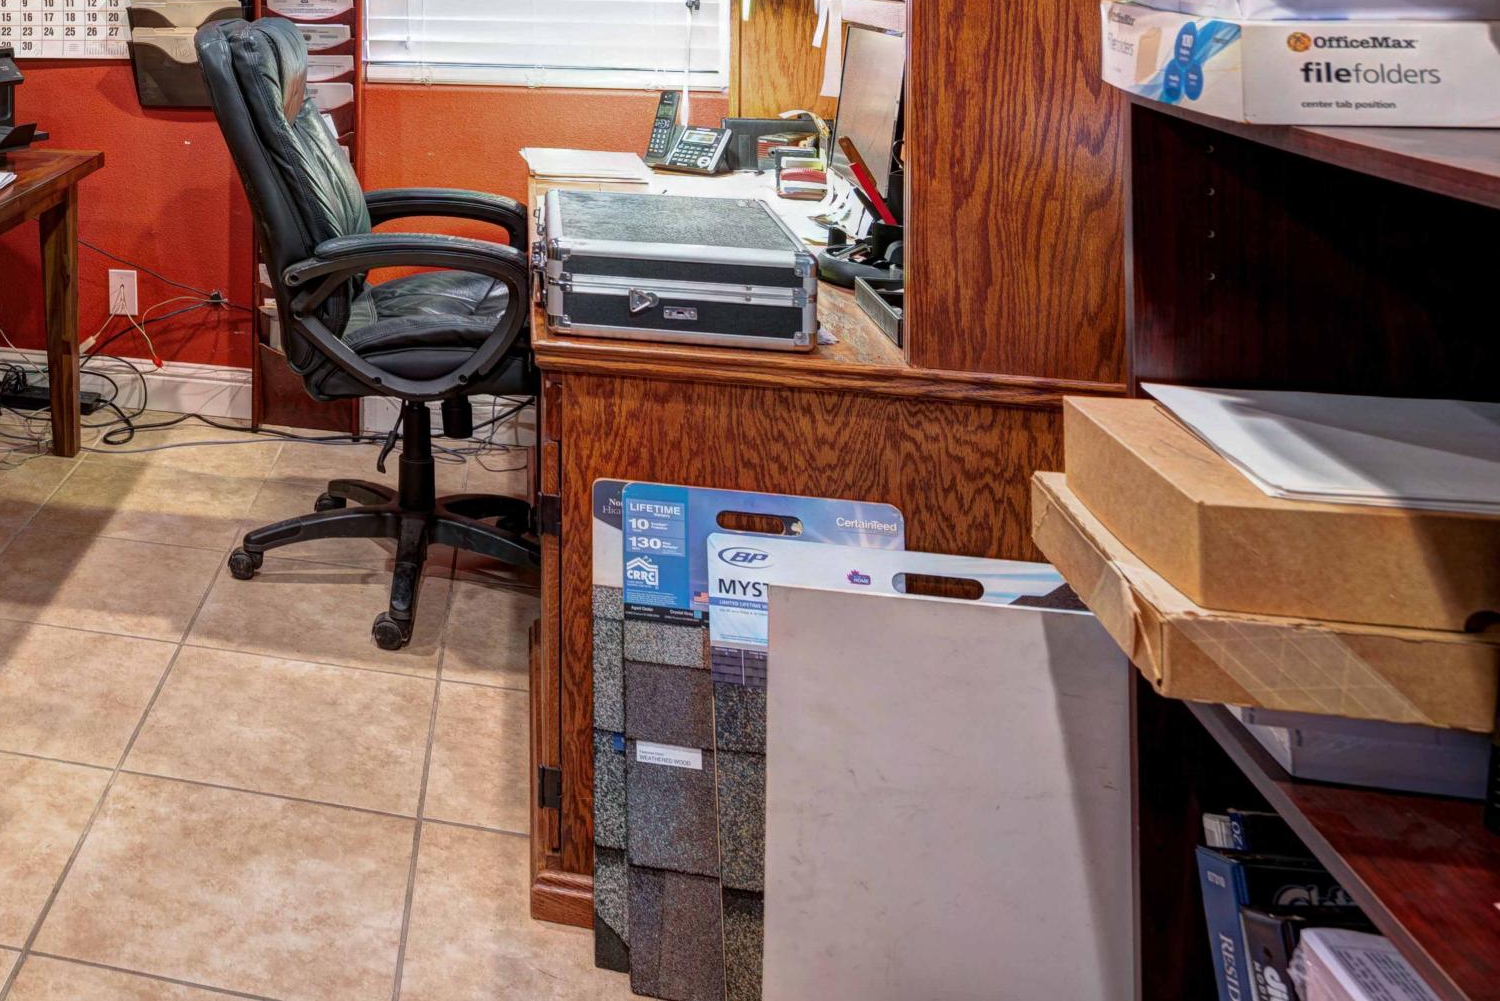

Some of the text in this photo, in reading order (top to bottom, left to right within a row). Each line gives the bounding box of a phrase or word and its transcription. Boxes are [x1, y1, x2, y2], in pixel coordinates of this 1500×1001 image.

[2, 13, 11, 22] 15
[23, 13, 32, 22] 16
[44, 13, 54, 22] 17
[65, 13, 75, 22] 18
[87, 13, 97, 22] 19
[109, 13, 118, 22] 20
[1, 27, 11, 36] 22
[23, 27, 32, 36] 23
[44, 27, 54, 36] 24
[65, 27, 75, 36] 25
[87, 27, 97, 36] 26
[109, 27, 119, 36] 27
[23, 42, 32, 50] 30
[1314, 36, 1417, 49] OfficeMax
[1301, 62, 1441, 84] filefolders
[1355, 101, 1396, 109] position
[609, 498, 623, 506] No
[630, 503, 681, 515] LIFETIME
[629, 518, 649, 530] 10
[836, 517, 897, 532] CertainTeed
[629, 536, 661, 549] 130
[729, 552, 769, 563] BP
[627, 569, 655, 581] CRRC
[640, 755, 673, 764] WEATHERED
